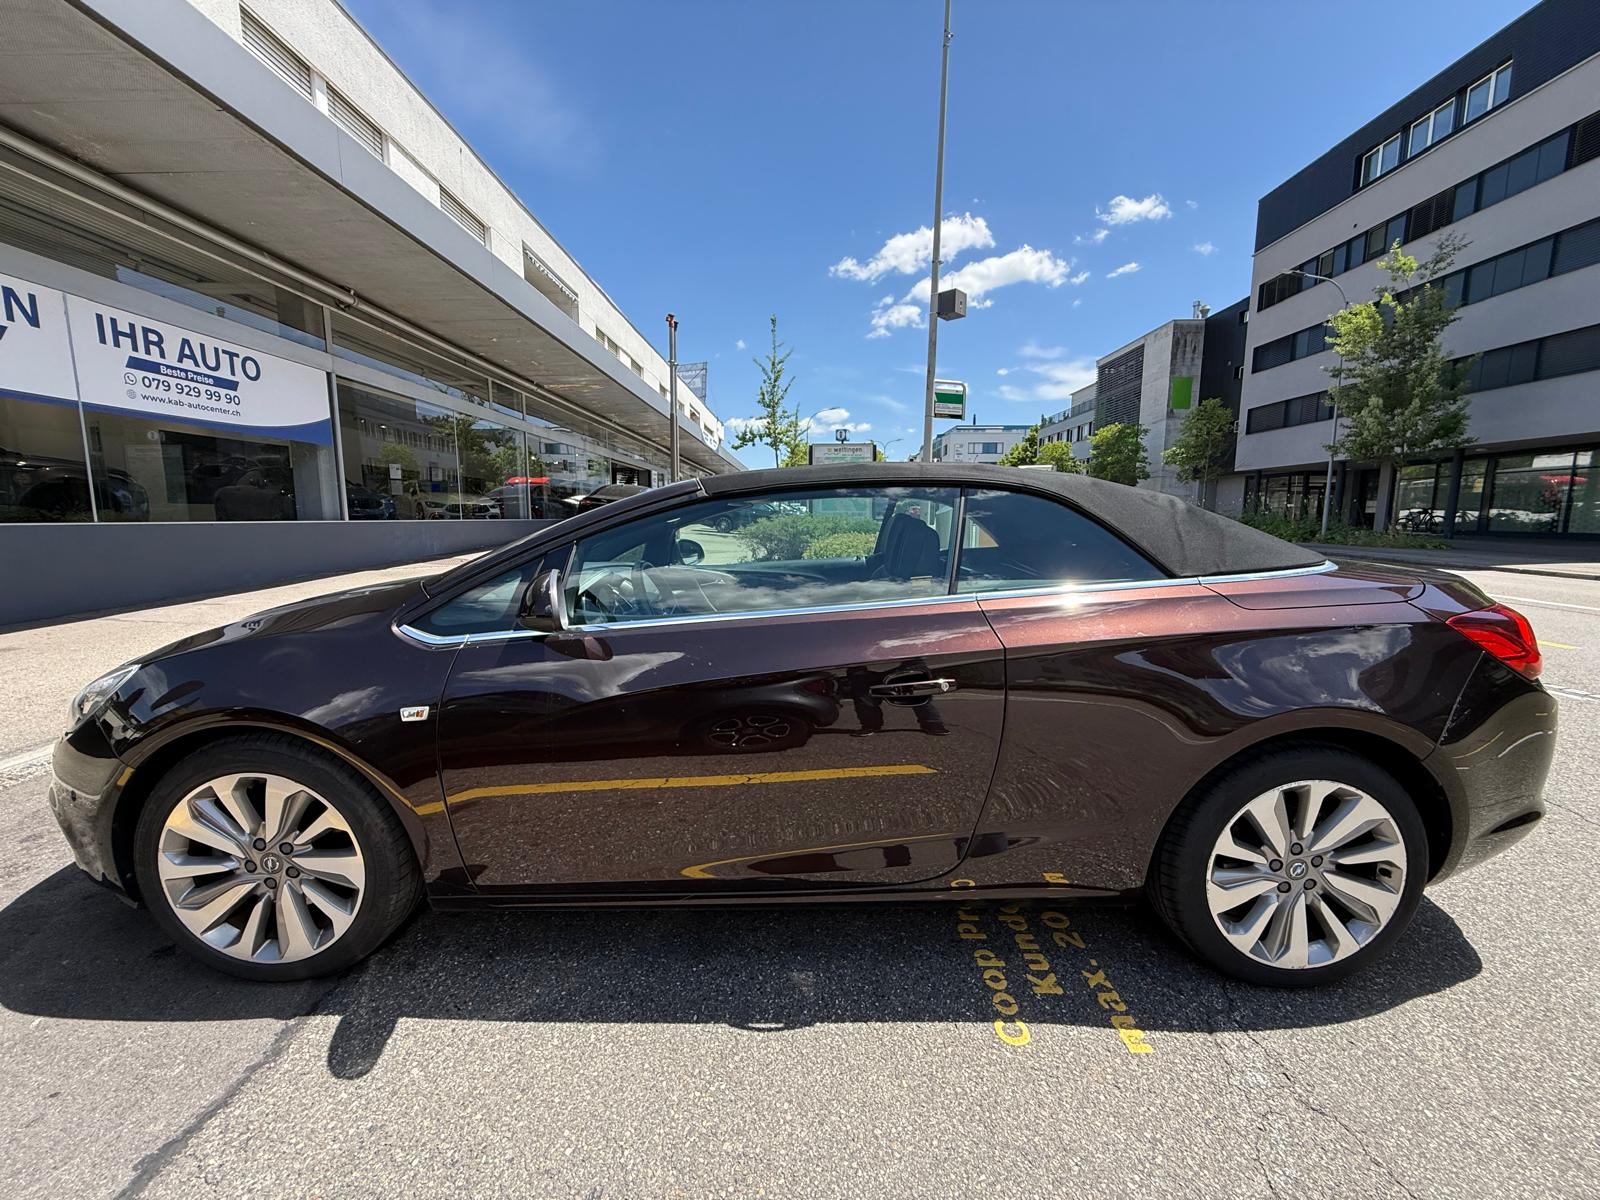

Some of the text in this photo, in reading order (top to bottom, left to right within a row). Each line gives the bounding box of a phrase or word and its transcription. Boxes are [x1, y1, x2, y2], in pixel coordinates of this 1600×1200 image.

[95, 312, 261, 382] IHR AUTO
[141, 375, 241, 406] 079 929 99 90
[159, 364, 214, 385] Beste Preise
[140, 393, 241, 417] www.kab-autocenter.ch
[974, 949, 1031, 1046] Coop
[1040, 911, 1154, 1054] max. 20
